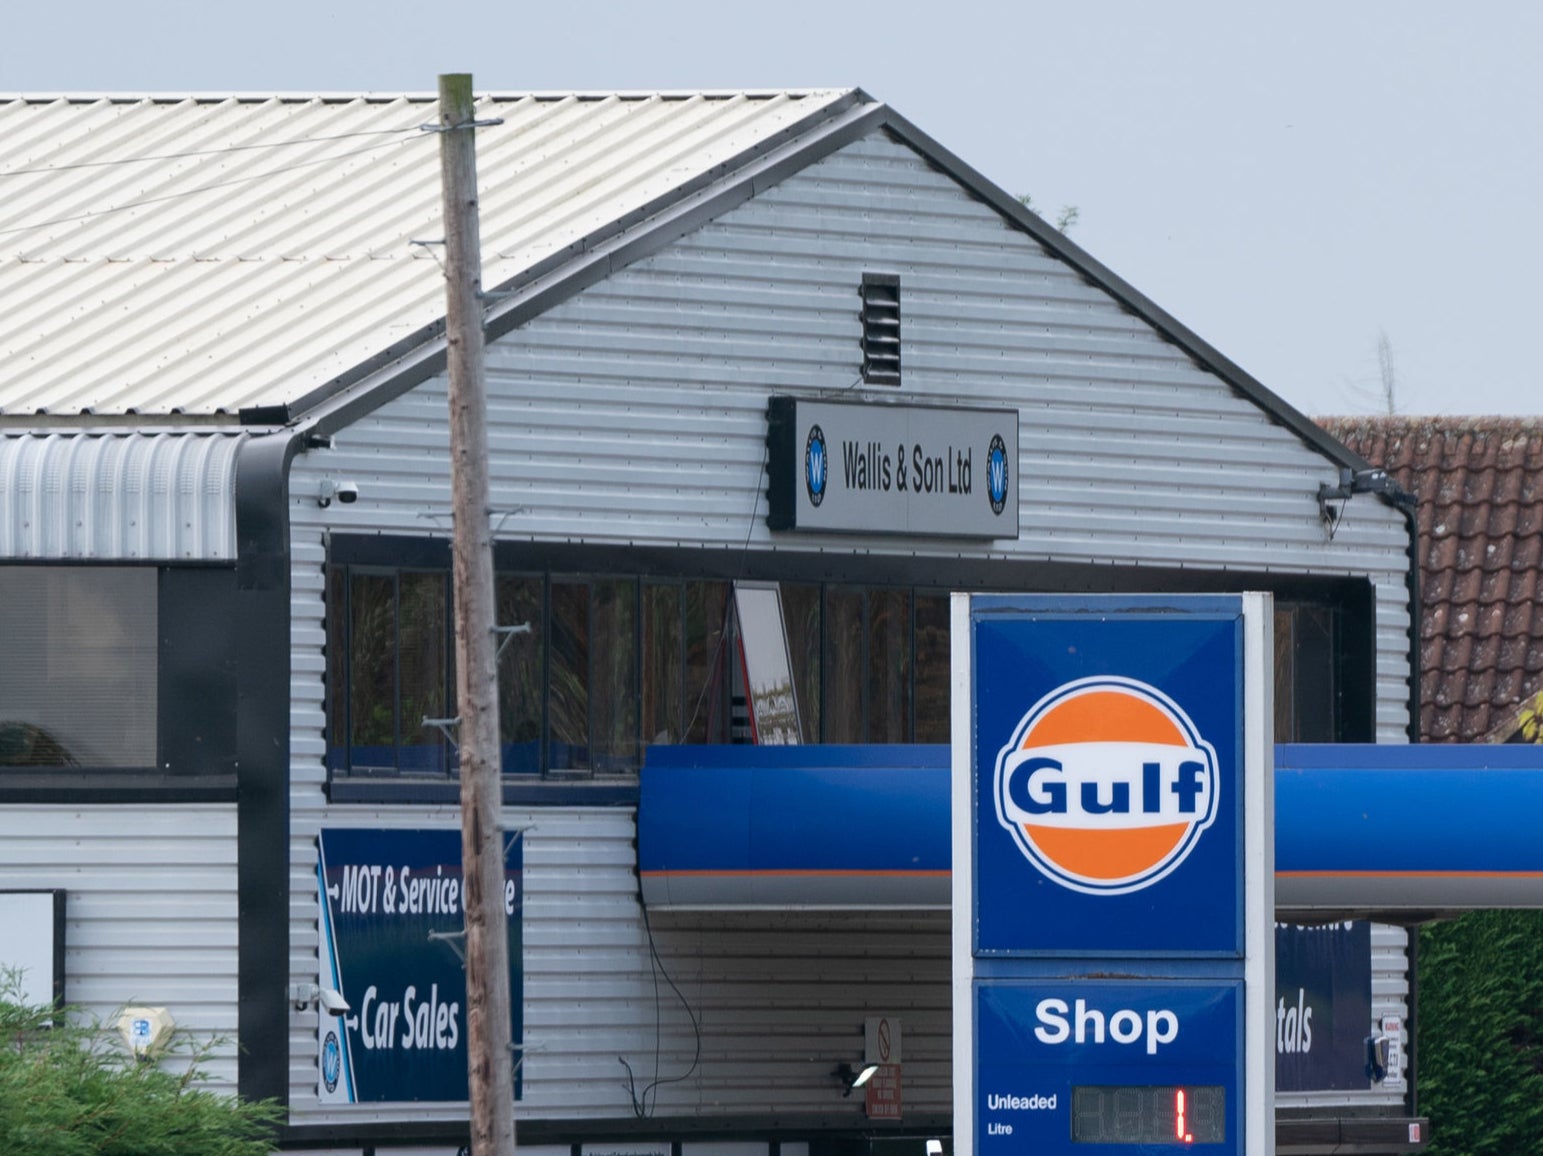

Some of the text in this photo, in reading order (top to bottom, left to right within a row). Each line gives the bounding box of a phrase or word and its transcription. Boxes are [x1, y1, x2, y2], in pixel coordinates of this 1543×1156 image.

[842, 440, 972, 495] Wallis & Son Ltd
[1008, 756, 1206, 815] Gulf
[340, 864, 381, 914] MOT
[383, 865, 397, 914] &
[398, 864, 458, 914] Service
[361, 983, 459, 1050] Car Sales
[1034, 998, 1180, 1055] Shop
[1277, 987, 1312, 1054] tals
[987, 1094, 1057, 1110] Unleaded
[987, 1123, 1013, 1135] Litre
